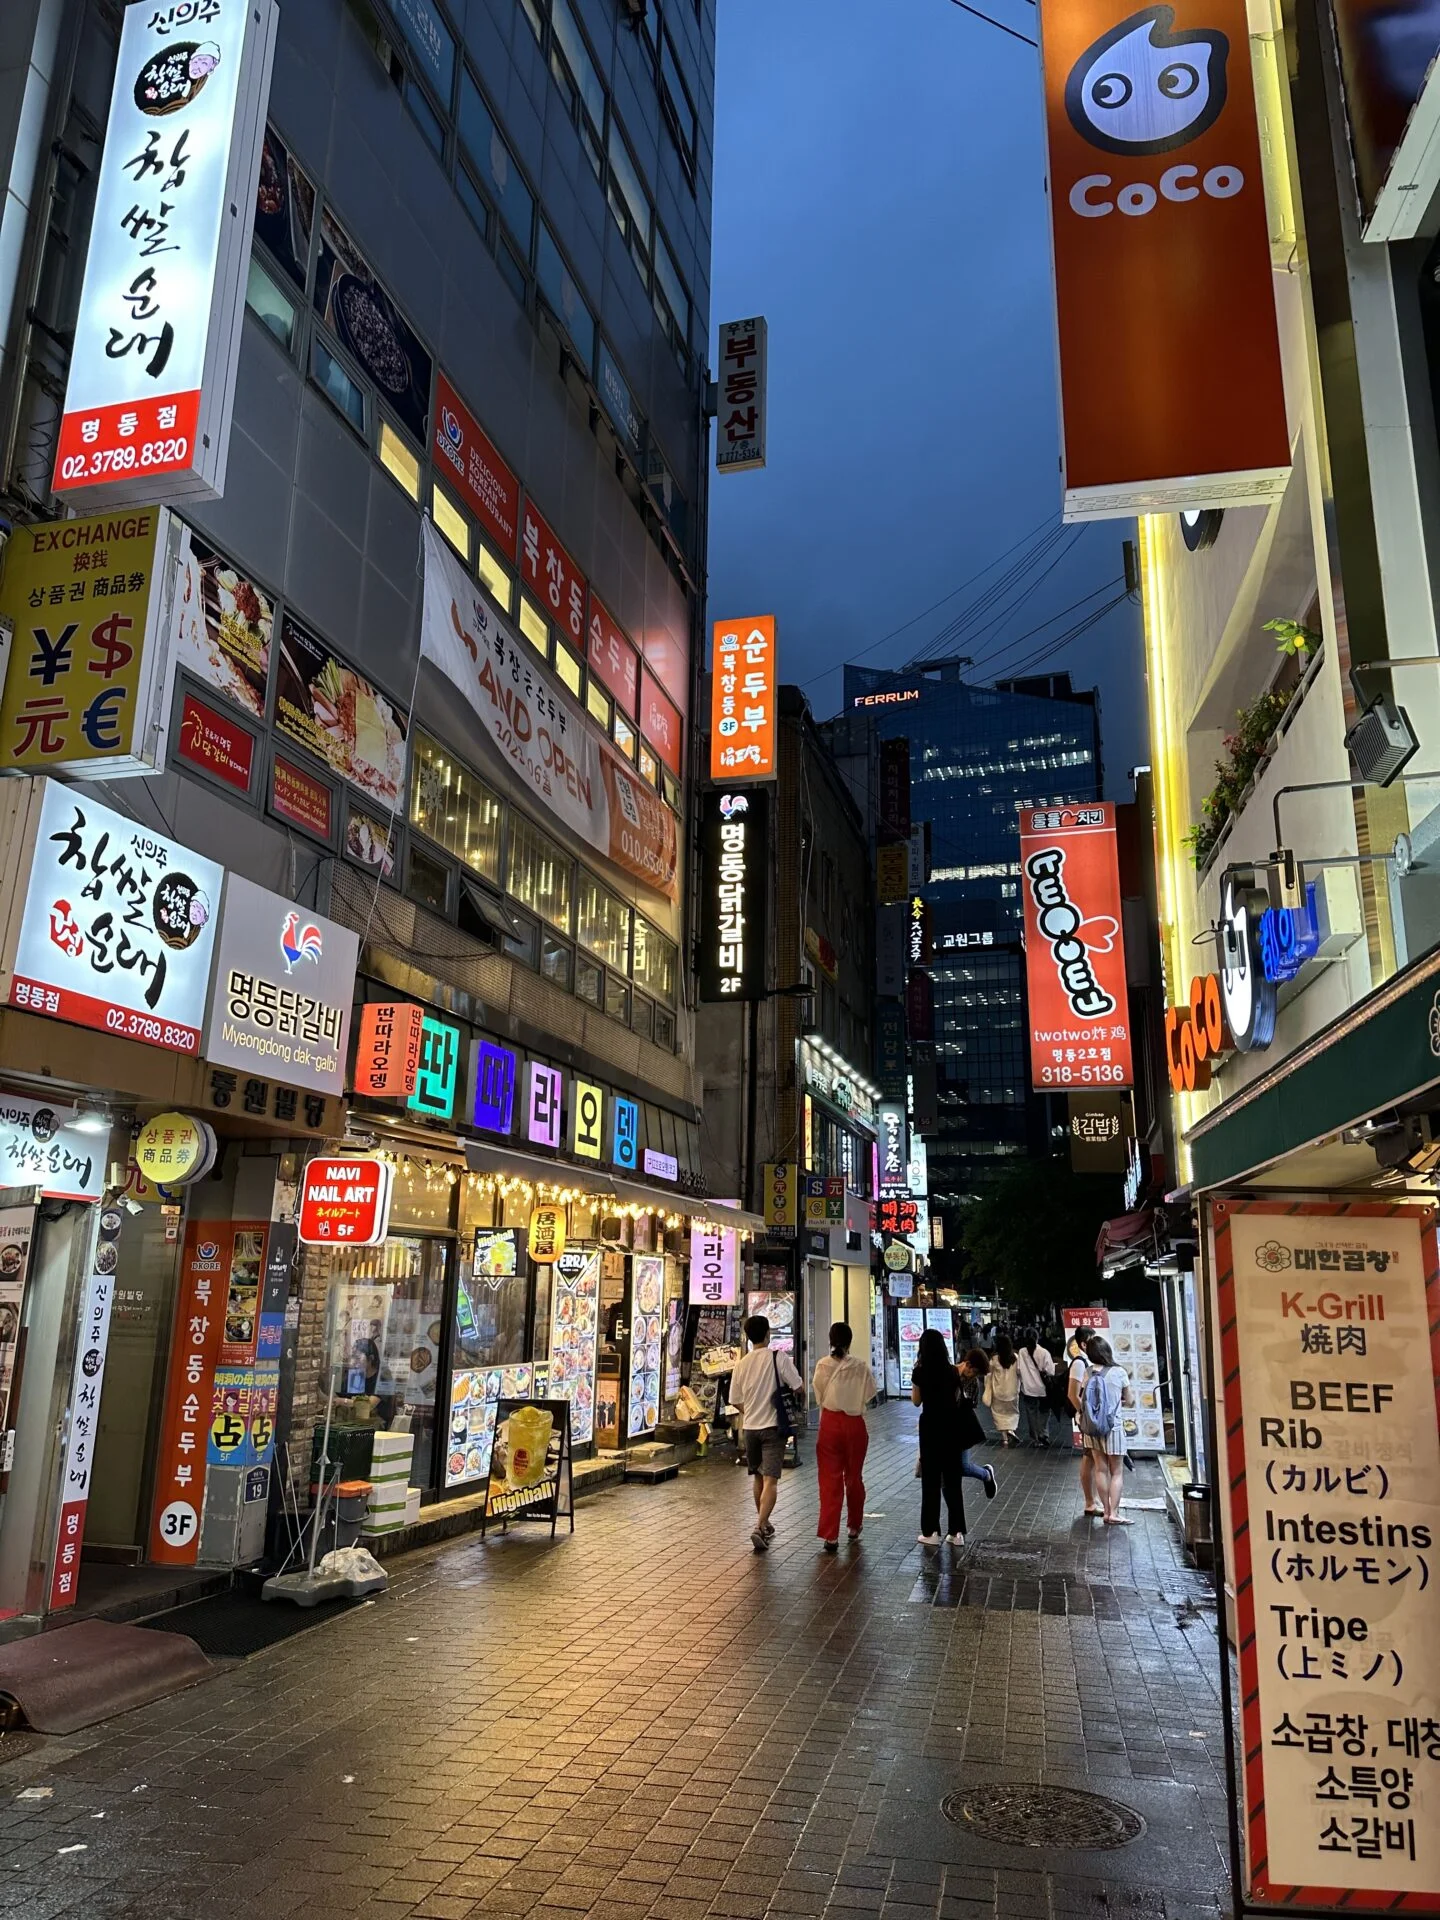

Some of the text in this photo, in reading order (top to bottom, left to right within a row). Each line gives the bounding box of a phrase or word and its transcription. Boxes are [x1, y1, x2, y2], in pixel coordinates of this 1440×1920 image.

[1068, 164, 1245, 218] CoCo
[724, 335, 758, 442] 부동산
[62, 438, 188, 480] 02.3789.8320
[437, 428, 464, 477] DKORE
[469, 459, 498, 504] KOREAN
[470, 446, 507, 504] DELICIOUS
[33, 517, 150, 553] EXCHANGE
[28, 582, 85, 606] 상품권
[721, 654, 737, 715] 북창동
[741, 629, 768, 733] 순두부
[854, 690, 919, 707] FERRUM
[722, 722, 735, 731] 3F
[1077, 810, 1104, 825] 치킨
[131, 834, 168, 869] 신의주
[717, 822, 746, 974] 명동닭갈비
[943, 932, 993, 948] 교원그룹
[15, 982, 60, 1012] 명동점
[720, 977, 742, 993] 2F
[228, 970, 343, 1051] 명동닭갈비
[106, 1008, 195, 1050] 02.3789.8320
[222, 1022, 337, 1072] Myeongdong dak-galbi
[370, 1007, 395, 1089] 딴따라오뎅
[1041, 1065, 1124, 1083] 318-5136
[146, 1129, 192, 1145] 상품권
[1080, 1118, 1111, 1135] 김밥
[326, 1167, 361, 1180] NAVI
[308, 1186, 375, 1203] NAIL ART
[316, 1207, 360, 1218] ネイルアート
[337, 1224, 355, 1236] 5F
[534, 1211, 556, 1255] 居酒屋
[192, 1262, 220, 1271] DKORE
[558, 1254, 589, 1268] ERRA
[1294, 1249, 1390, 1273] 대한곱창
[1281, 1291, 1385, 1321] K-Grill
[244, 1357, 254, 1365] 2F
[1290, 1380, 1394, 1413] BEEF
[1260, 1417, 1322, 1449] Rib
[220, 1453, 231, 1461] 5F
[252, 1484, 262, 1498] 19
[1265, 1460, 1389, 1500] (カルビ)
[492, 1482, 554, 1515] Highball
[163, 1513, 192, 1537] 3F
[1266, 1510, 1432, 1548] Intestins
[58, 1511, 79, 1595] 명동점
[1271, 1548, 1429, 1591] (ホルモン)
[1270, 1605, 1368, 1648] Tripe
[1271, 1713, 1379, 1757] 소곱창,
[1316, 1766, 1414, 1810] 소특양
[1318, 1817, 1416, 1861] 소갈비
